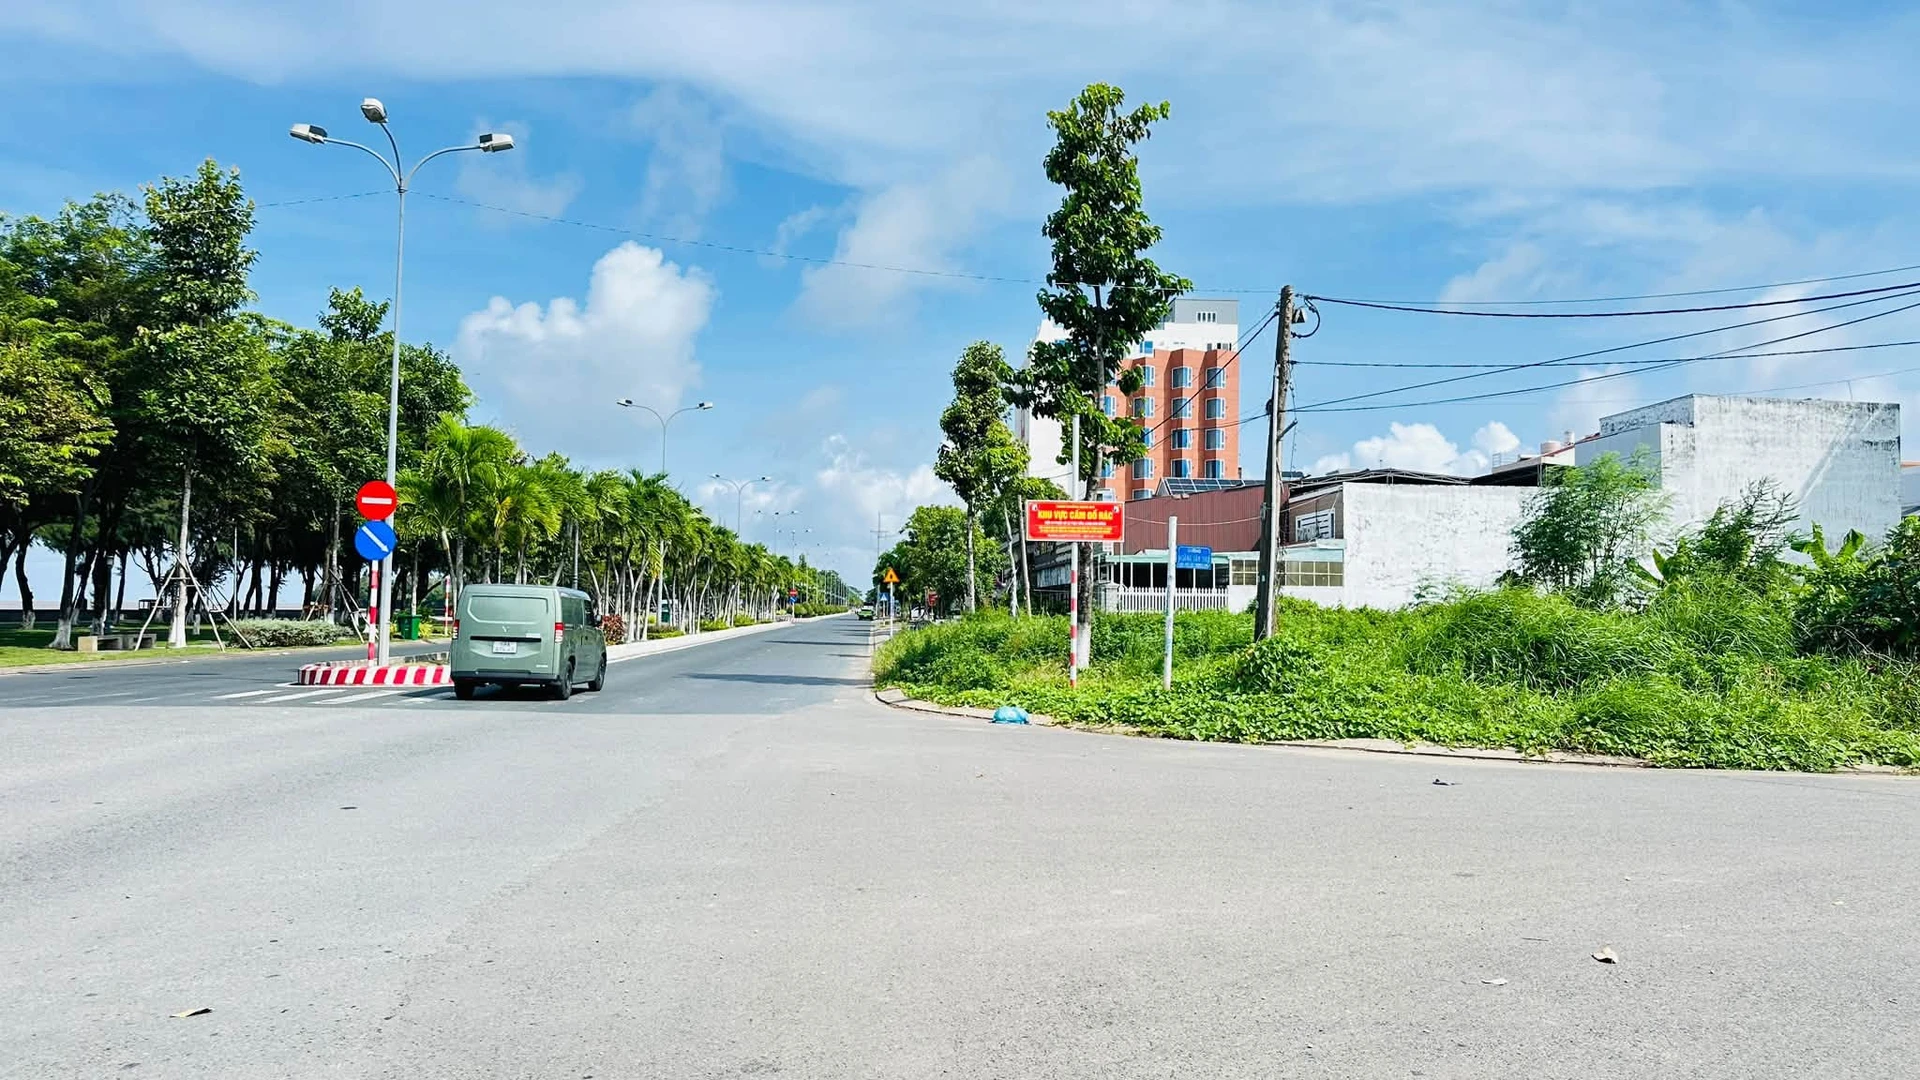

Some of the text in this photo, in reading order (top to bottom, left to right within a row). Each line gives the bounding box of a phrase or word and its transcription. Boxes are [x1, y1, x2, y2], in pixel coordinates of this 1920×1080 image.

[1038, 510, 1052, 519] KHU
[1054, 510, 1068, 520] VỰC
[1070, 509, 1085, 520] CẤM
[1099, 510, 1113, 520] RÁC
